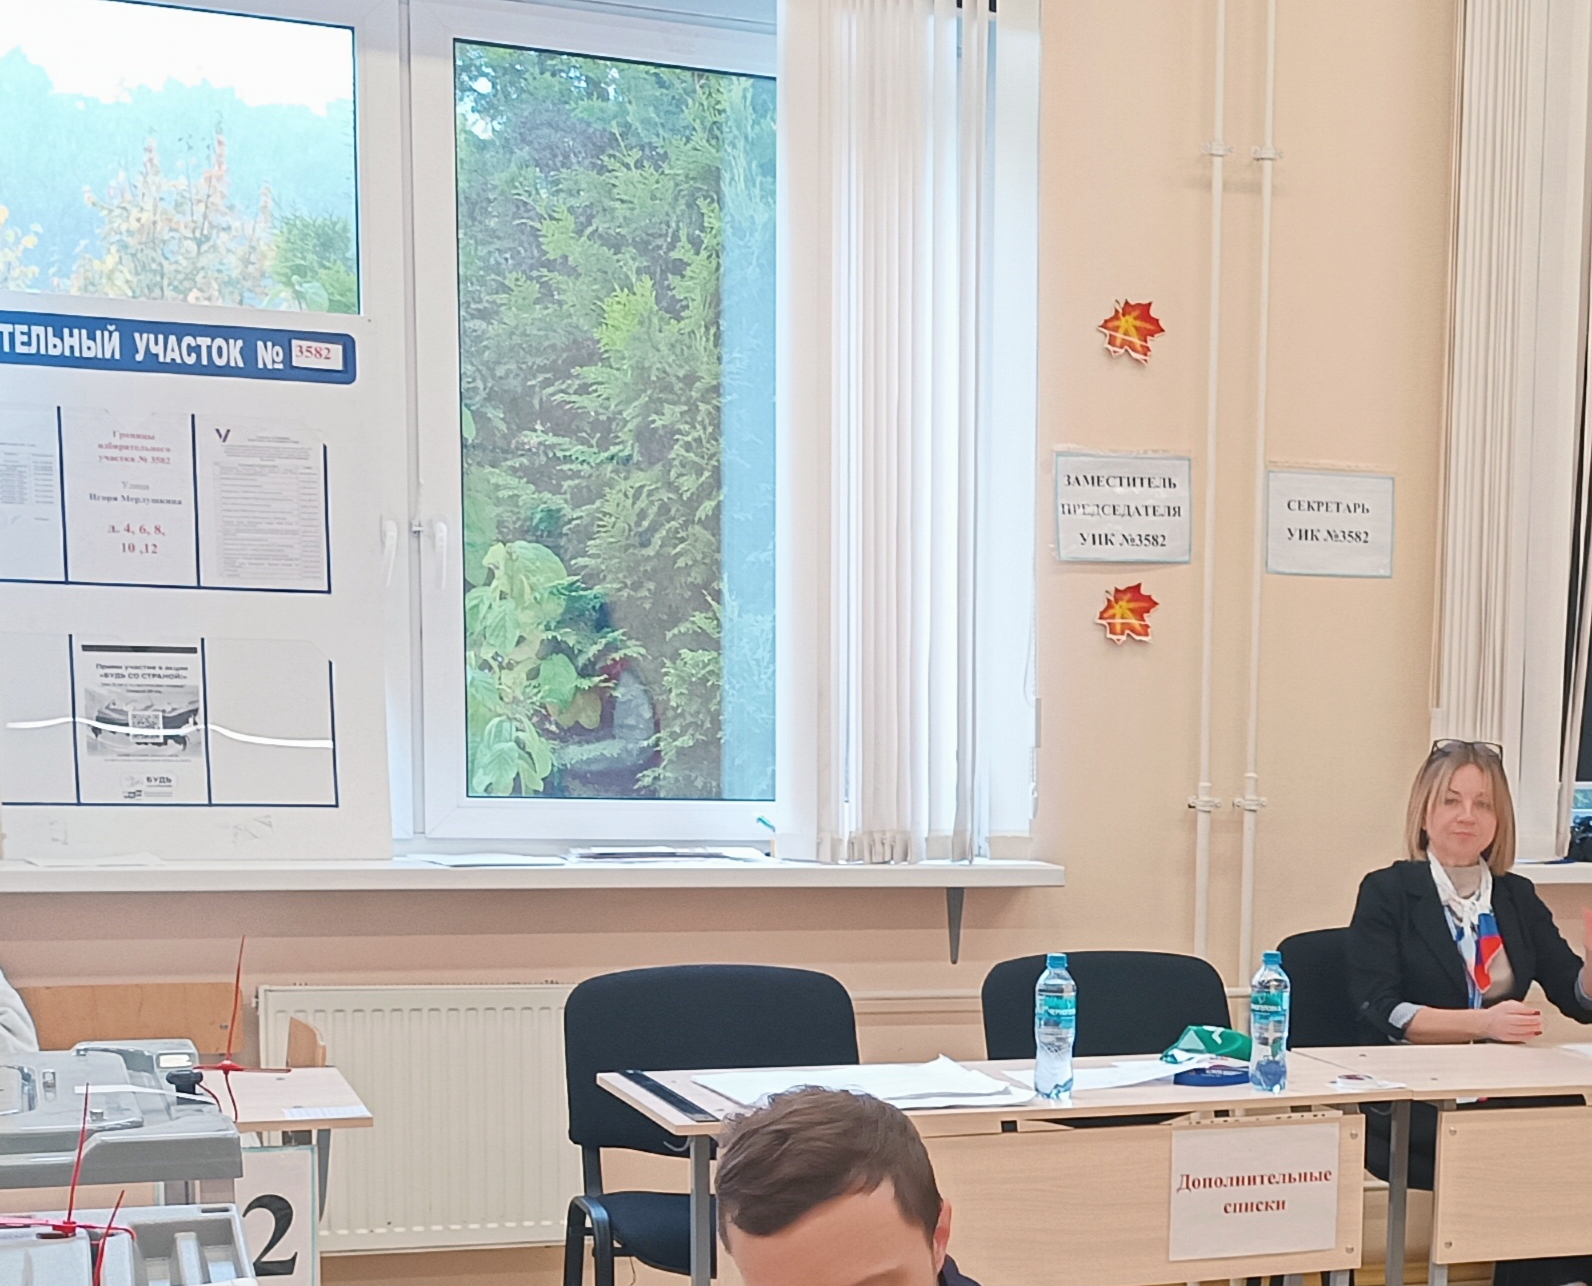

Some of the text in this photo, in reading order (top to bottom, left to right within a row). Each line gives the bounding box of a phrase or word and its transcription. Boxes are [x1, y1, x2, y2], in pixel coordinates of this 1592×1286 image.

[0, 323, 331, 369] ТЕЛЬНЫЙ УЧАСТОК № 3582
[1063, 474, 1178, 490] ЗАМЕСТИТЕЛЬ
[1061, 503, 1182, 518] ПРЕДСЕДАТЕЛЯ
[1287, 499, 1370, 514] СЕКРЕТАРЬ
[1079, 532, 1167, 548] УИК №3582
[1287, 527, 1370, 544] УИК №3582
[1176, 1169, 1333, 1194] Дополнительные
[1223, 1199, 1287, 1214] списки
[242, 1194, 298, 1277] 2
